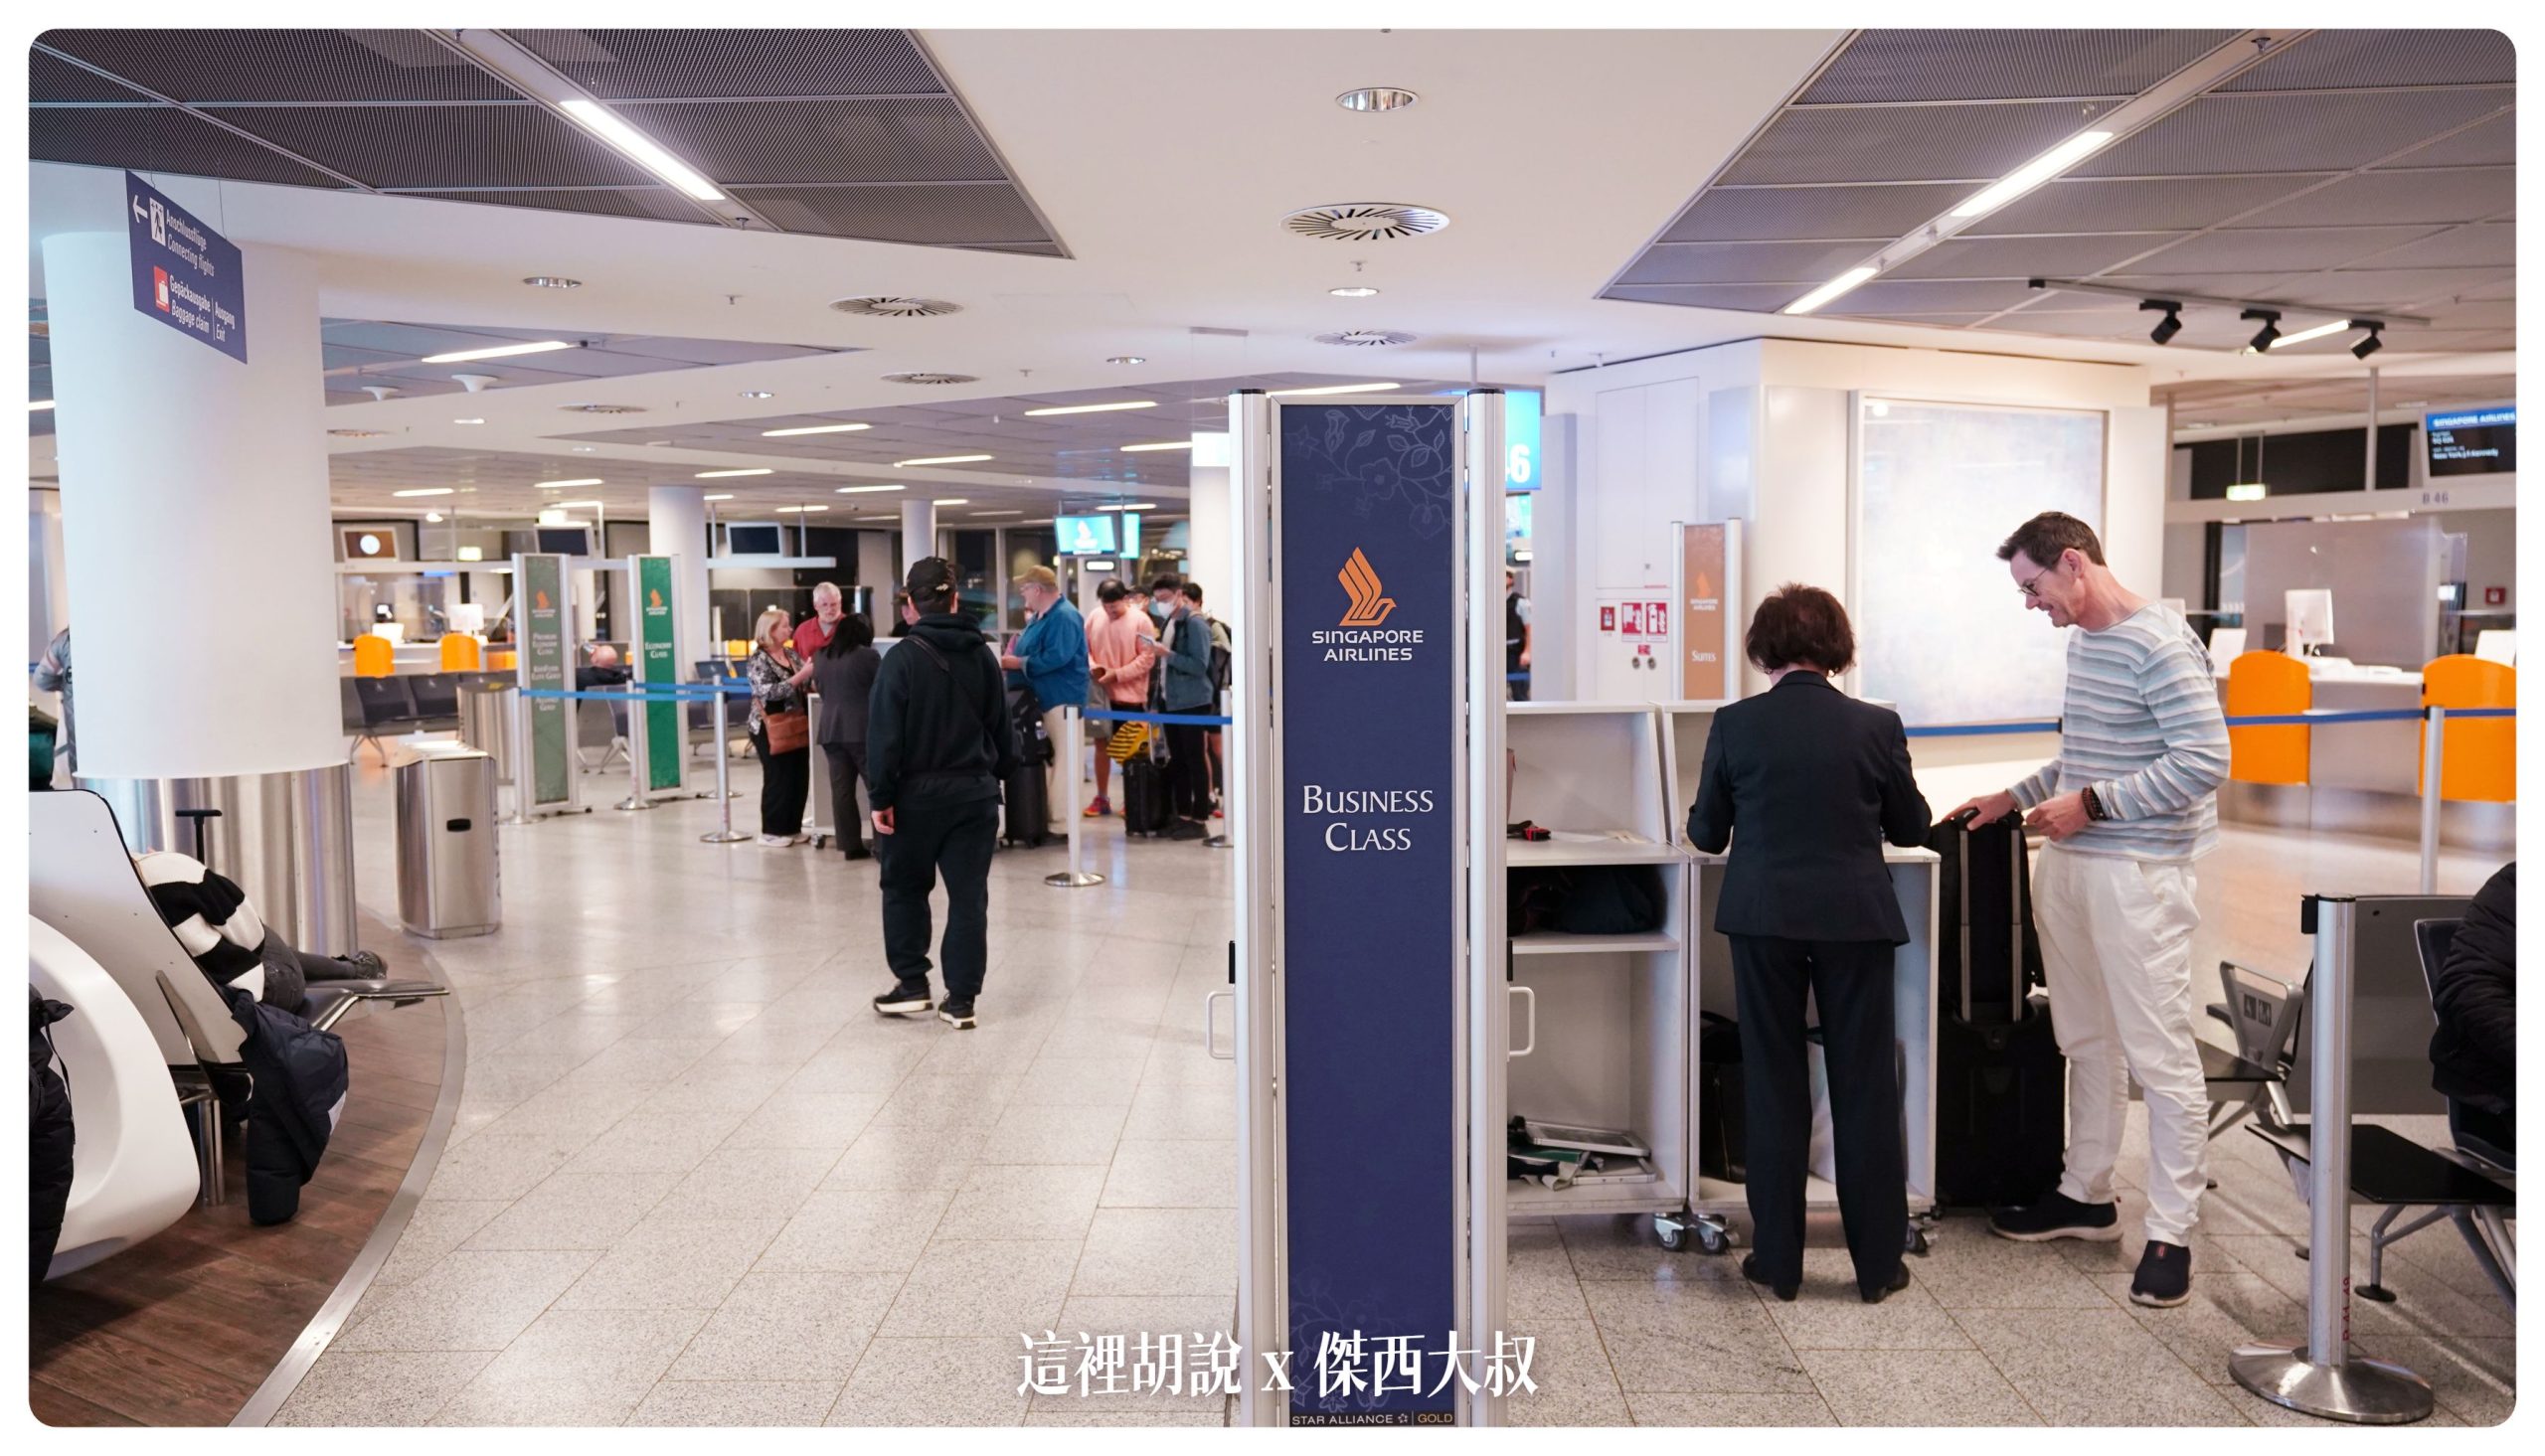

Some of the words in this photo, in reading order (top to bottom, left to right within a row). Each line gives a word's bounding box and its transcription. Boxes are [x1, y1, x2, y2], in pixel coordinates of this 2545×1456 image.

[166, 209, 207, 250] Anschlussflüge
[168, 236, 198, 270] Connecting
[199, 255, 215, 277] flights
[169, 274, 211, 312] Gepäckausgabe
[171, 301, 195, 326] Baggage
[195, 311, 210, 334] claim
[216, 324, 226, 342] Exit
[1311, 629, 1425, 645] SINGAPORE
[1323, 647, 1413, 663] AIRLINES
[1302, 785, 1435, 815] BUSINESS
[1324, 822, 1412, 853] CLASS
[1291, 1415, 1326, 1426] STAR
[1328, 1414, 1394, 1425] ALLIANCE
[1418, 1413, 1453, 1424] GOLD
